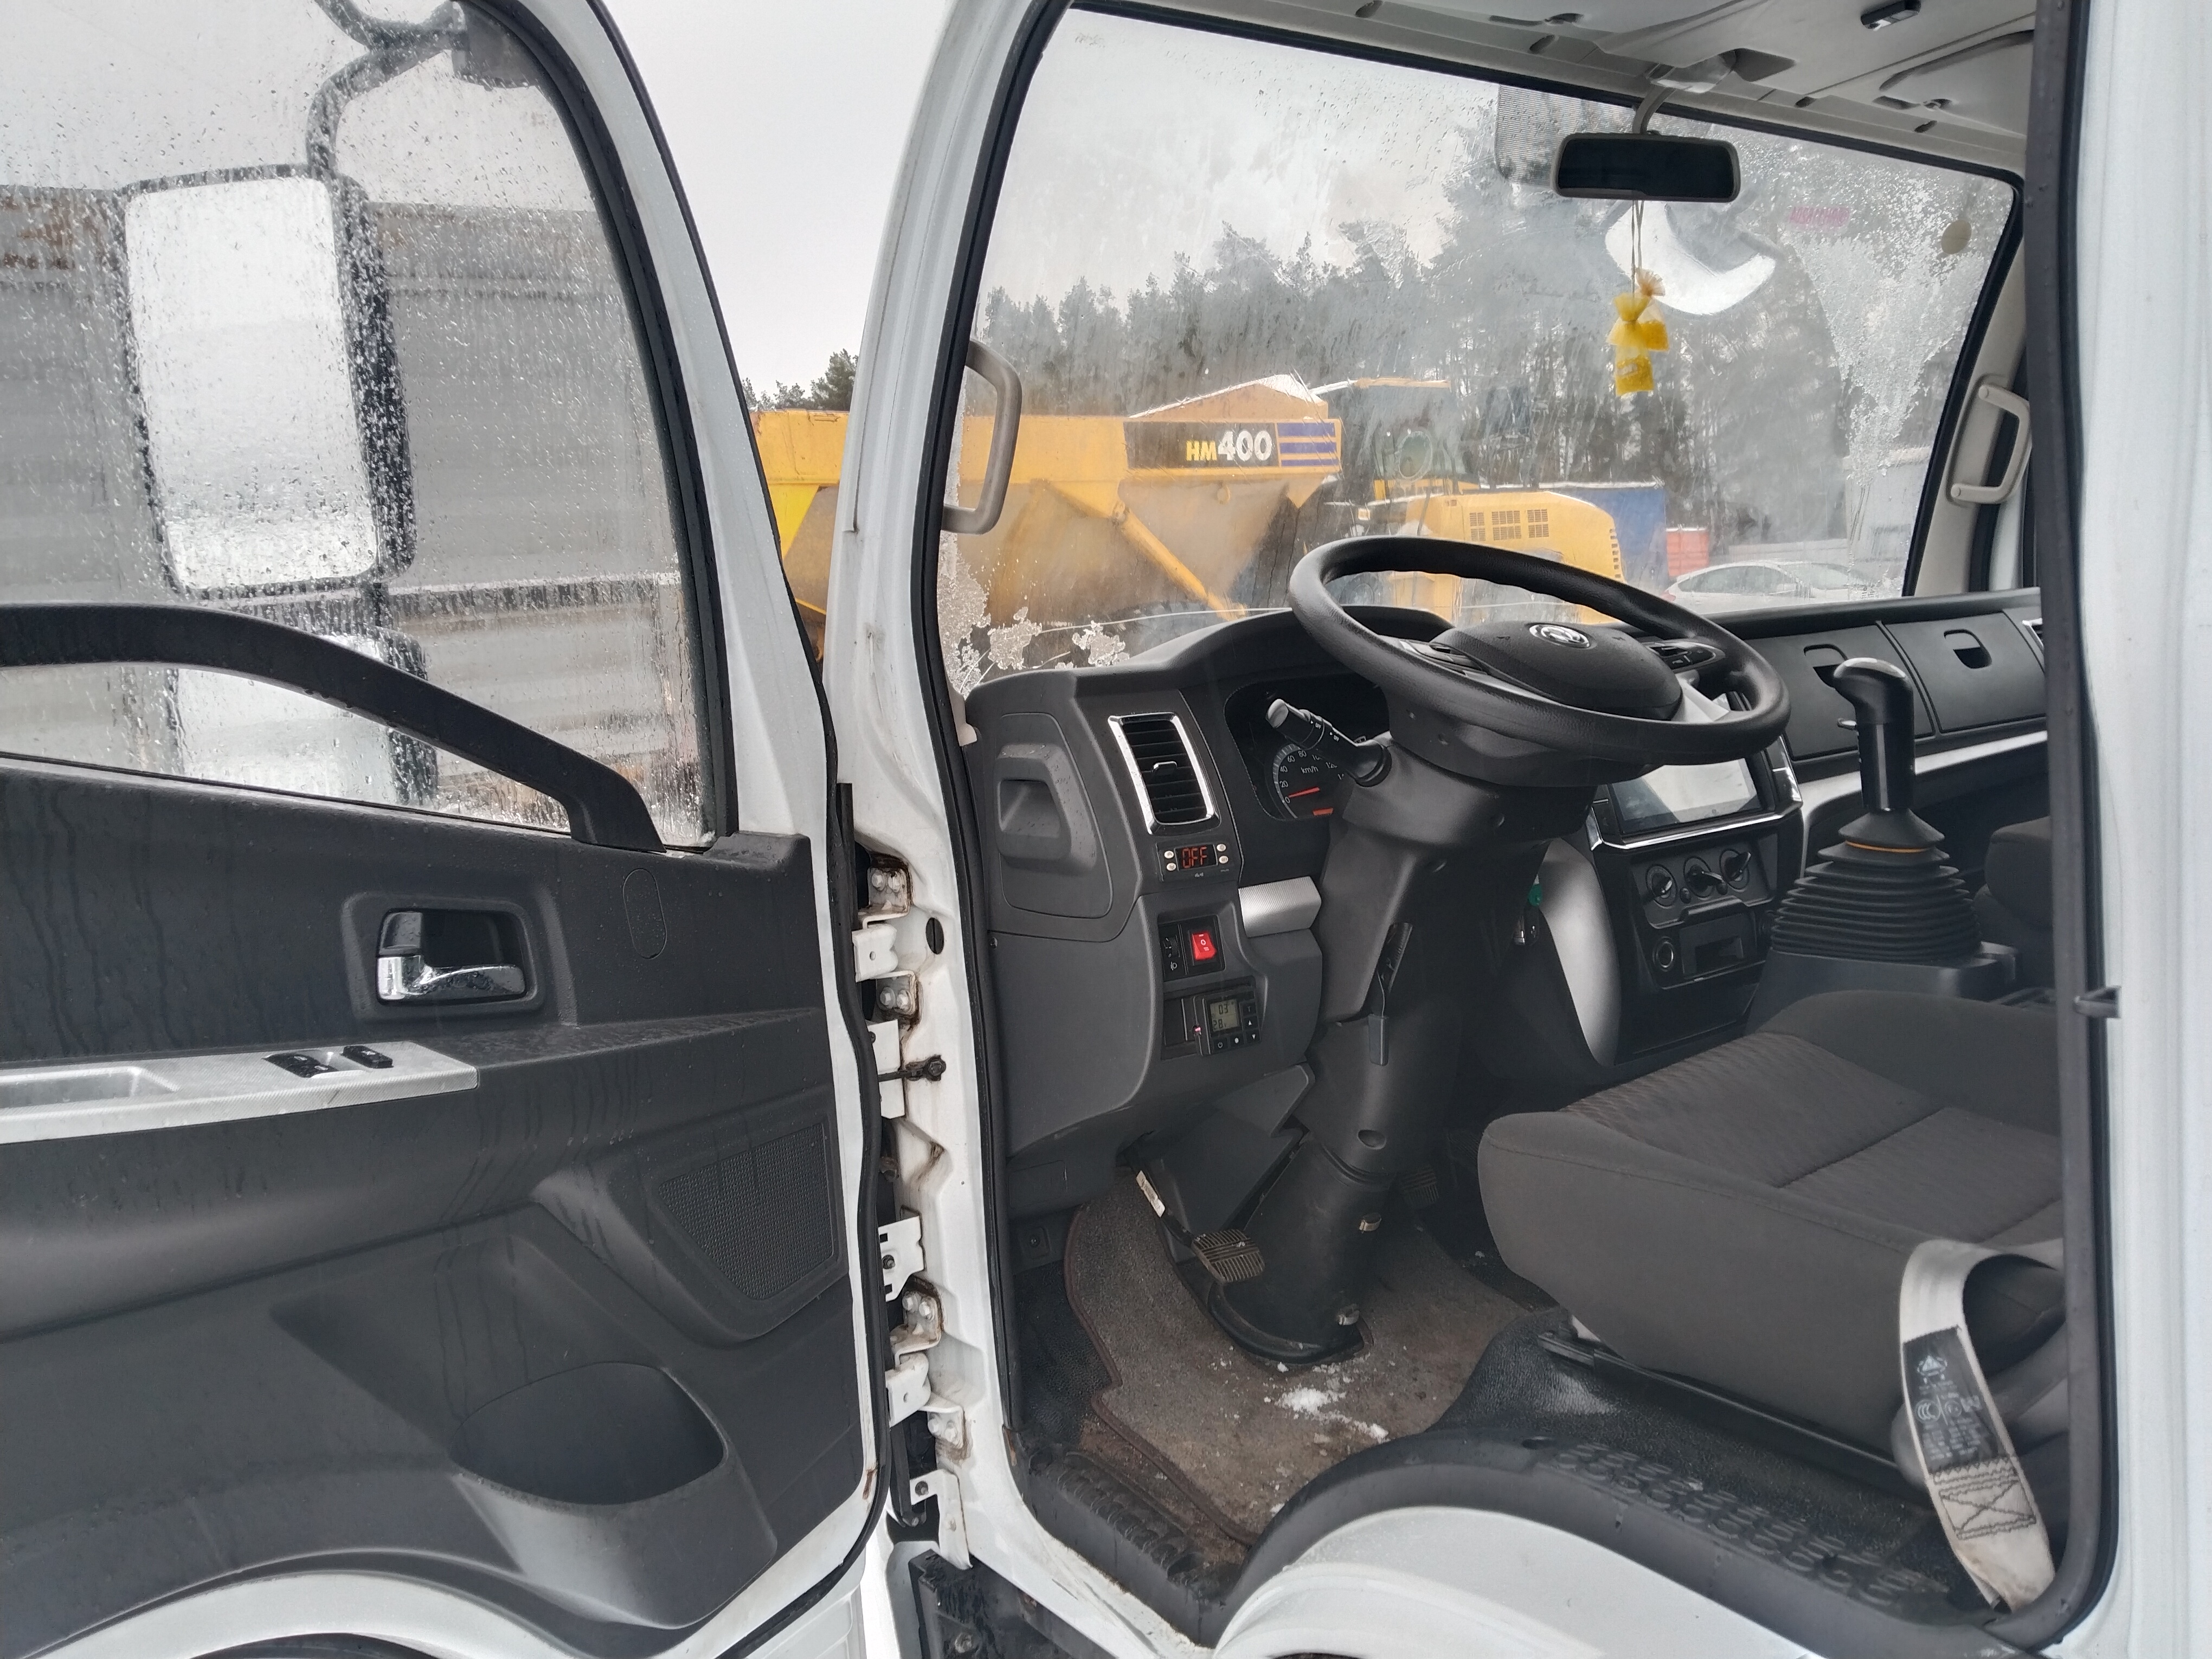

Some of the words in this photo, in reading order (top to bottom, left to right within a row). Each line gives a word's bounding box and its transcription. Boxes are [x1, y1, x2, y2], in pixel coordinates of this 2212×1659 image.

[1186, 430, 1273, 461] HM400
[1301, 765, 1319, 774] km/h
[1182, 846, 1207, 869] OFF
